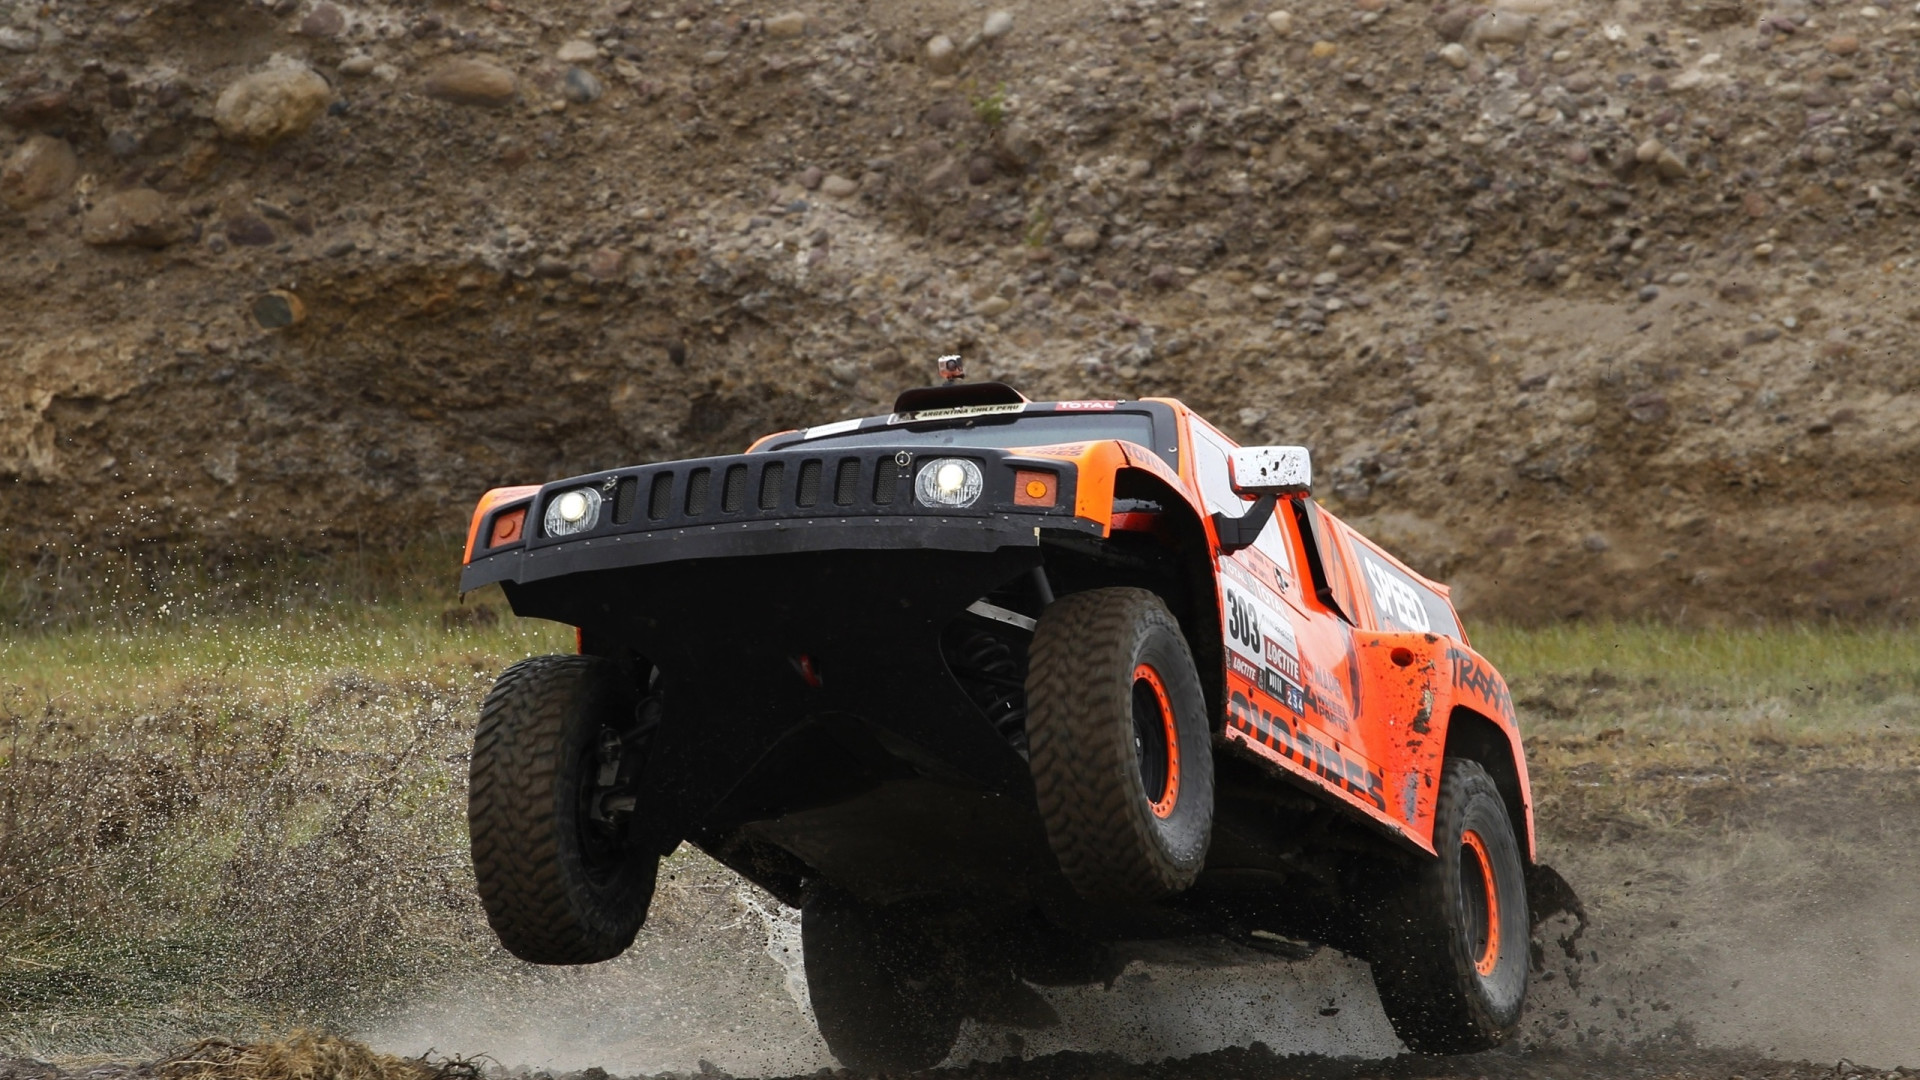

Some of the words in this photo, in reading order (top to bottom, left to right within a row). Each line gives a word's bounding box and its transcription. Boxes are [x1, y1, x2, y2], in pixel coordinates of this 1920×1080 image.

[921, 408, 968, 417] ARGENTINA
[970, 406, 994, 414] CHILE
[995, 404, 1020, 412] PERU
[1060, 401, 1115, 409] TOTAL
[1364, 557, 1430, 632] SPEED
[1227, 588, 1261, 654] 303
[1233, 656, 1257, 681] LOCTITE
[1267, 640, 1300, 681] LOCTITE
[1303, 684, 1318, 715] 4
[1319, 705, 1349, 732] PARTS
[1296, 730, 1386, 813] TIRES
